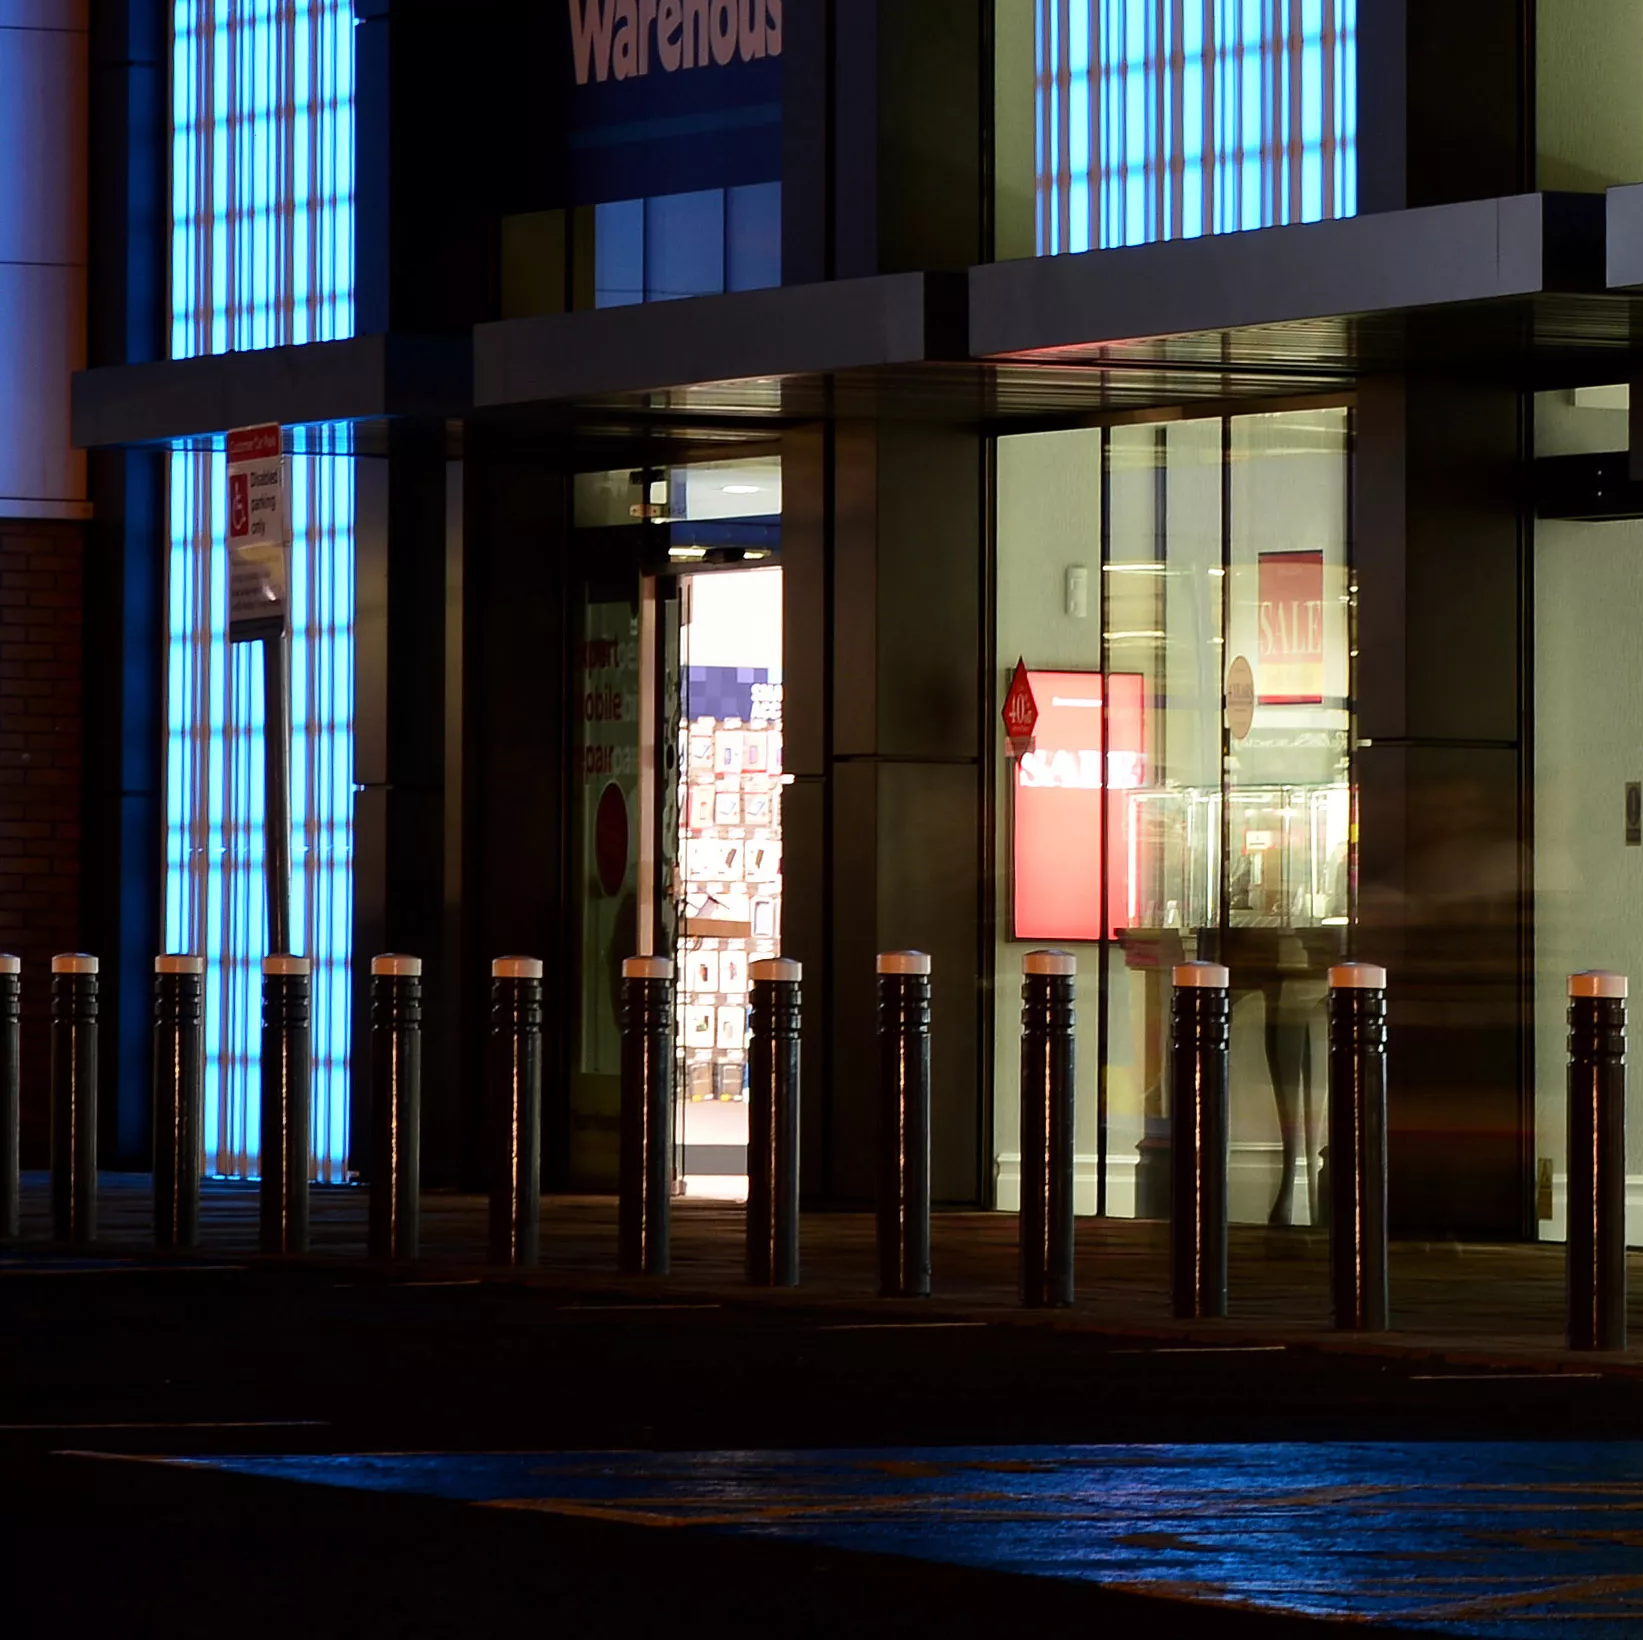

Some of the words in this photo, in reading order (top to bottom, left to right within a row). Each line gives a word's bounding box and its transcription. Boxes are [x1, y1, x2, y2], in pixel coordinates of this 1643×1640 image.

[250, 471, 277, 488] Disabled
[251, 495, 275, 512] parking
[251, 520, 265, 537] only
[1259, 600, 1322, 656] SALE
